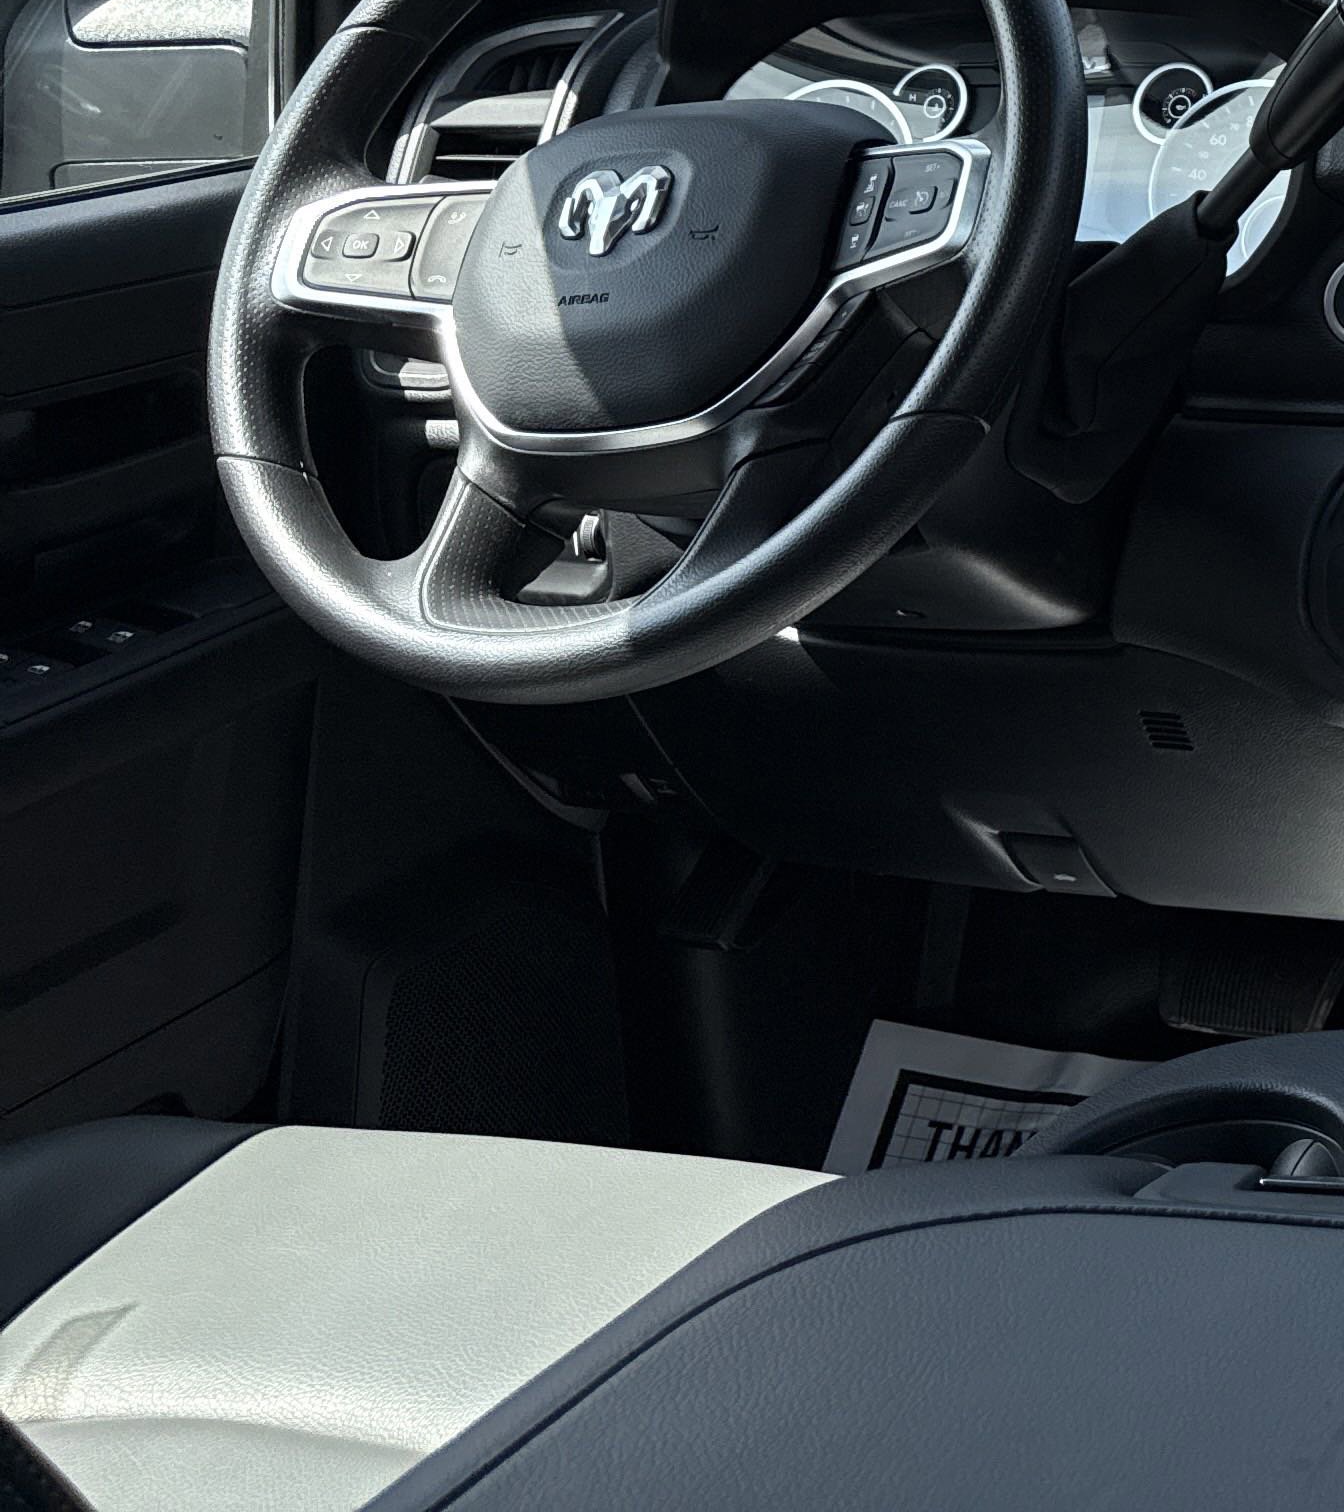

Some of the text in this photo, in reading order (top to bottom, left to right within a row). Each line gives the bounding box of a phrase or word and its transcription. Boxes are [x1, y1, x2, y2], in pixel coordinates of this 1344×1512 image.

[1208, 134, 1227, 146] 60
[1188, 169, 1208, 181] 40
[350, 238, 370, 251] OK
[558, 292, 610, 306] AIRBAG
